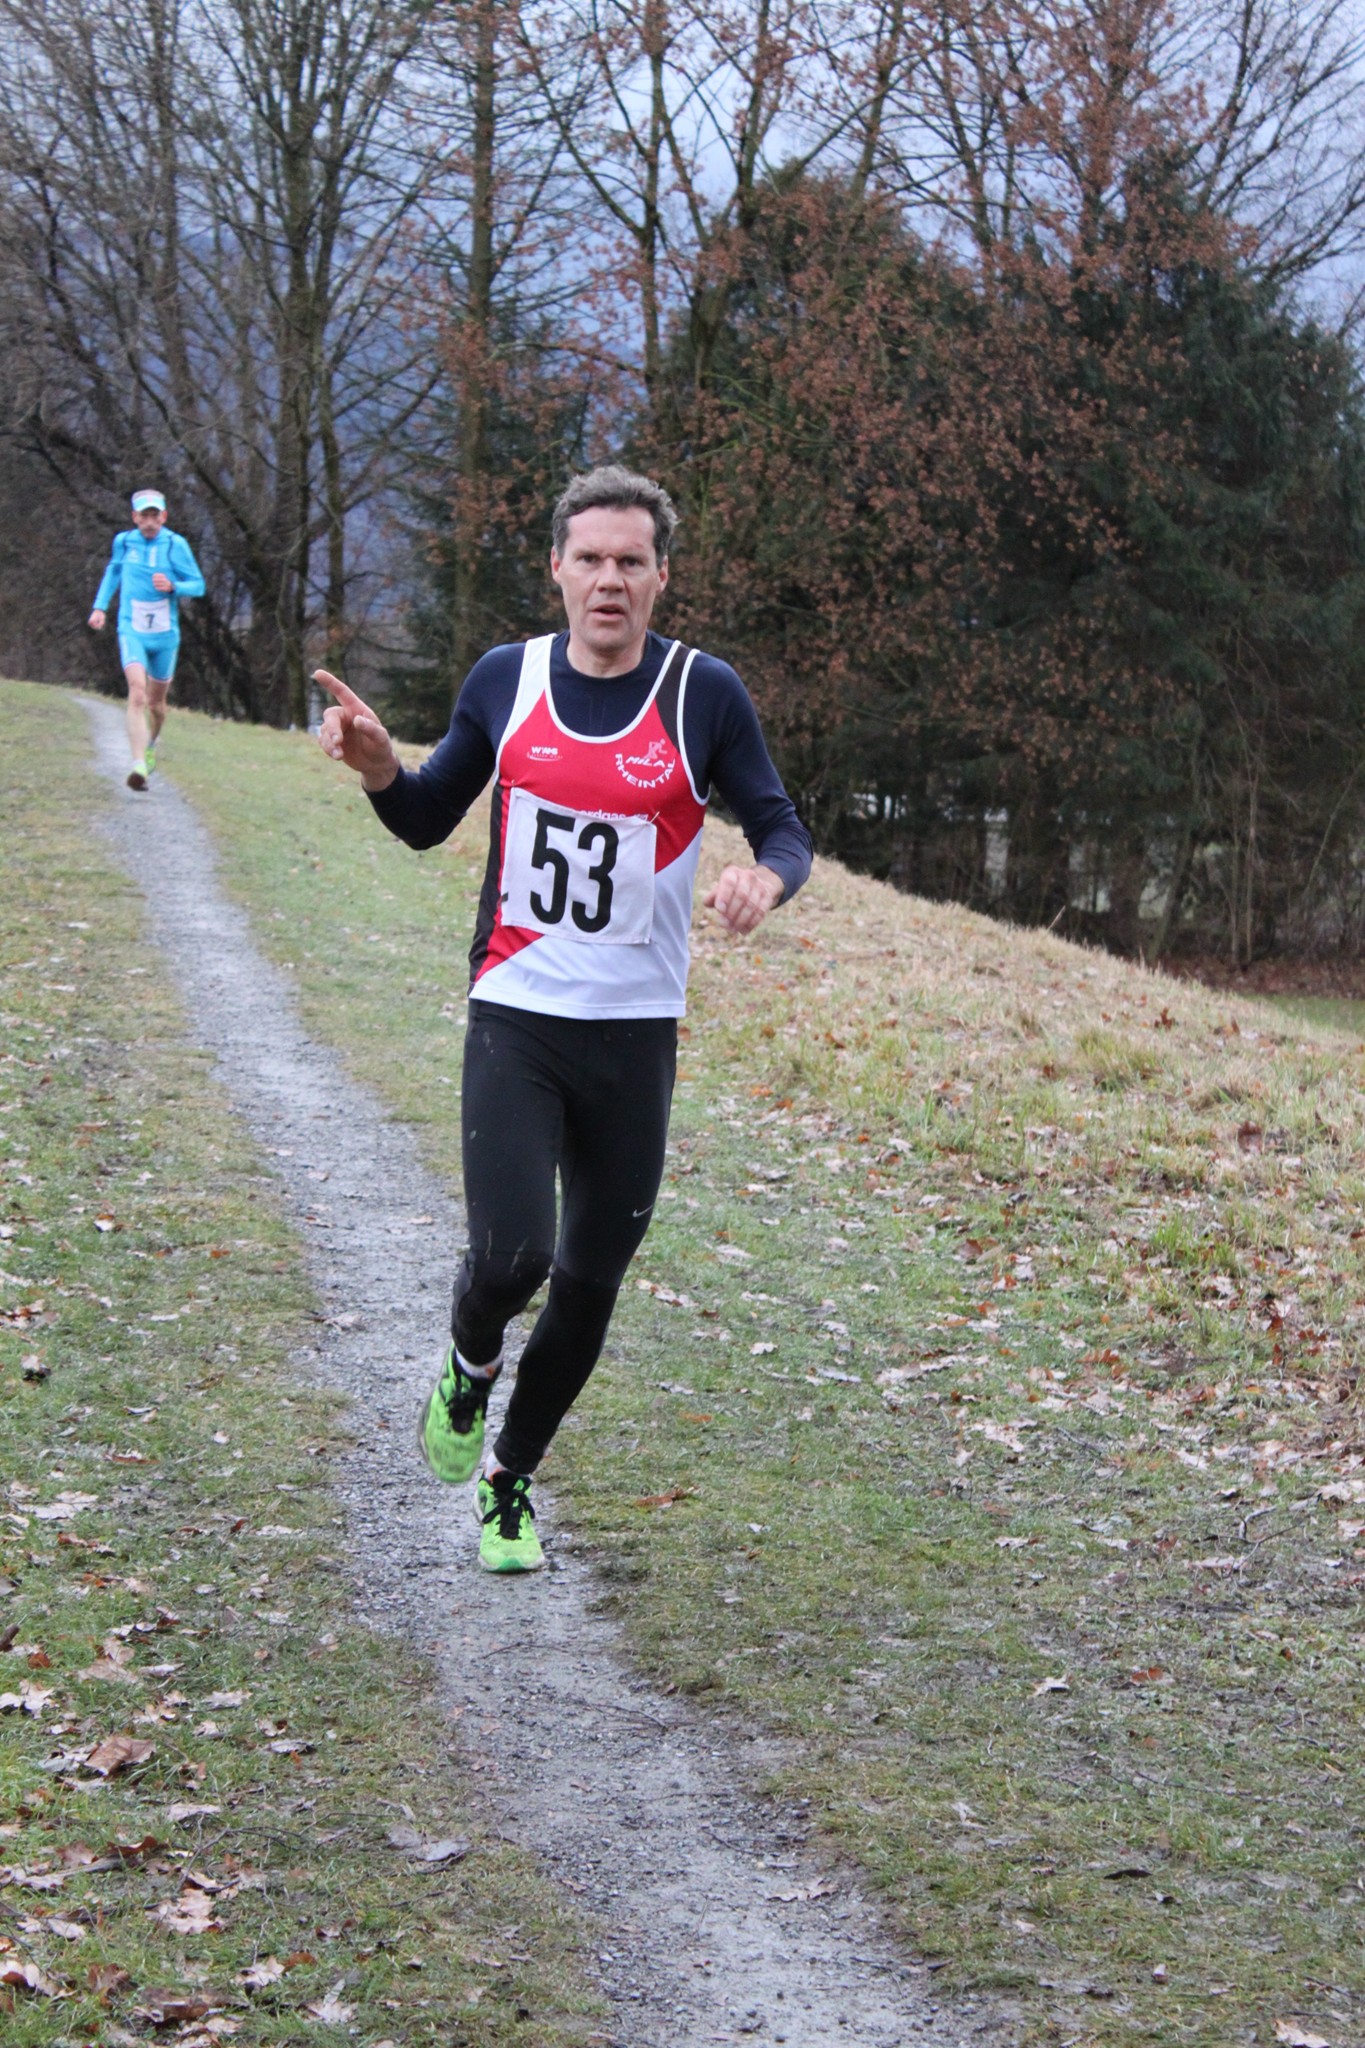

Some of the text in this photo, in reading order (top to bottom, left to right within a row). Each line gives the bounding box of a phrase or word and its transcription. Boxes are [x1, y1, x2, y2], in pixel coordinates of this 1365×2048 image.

[145, 614, 155, 629] 7
[615, 753, 676, 788] RHEINTAL
[626, 756, 666, 768] MILA
[530, 808, 619, 933] 53
